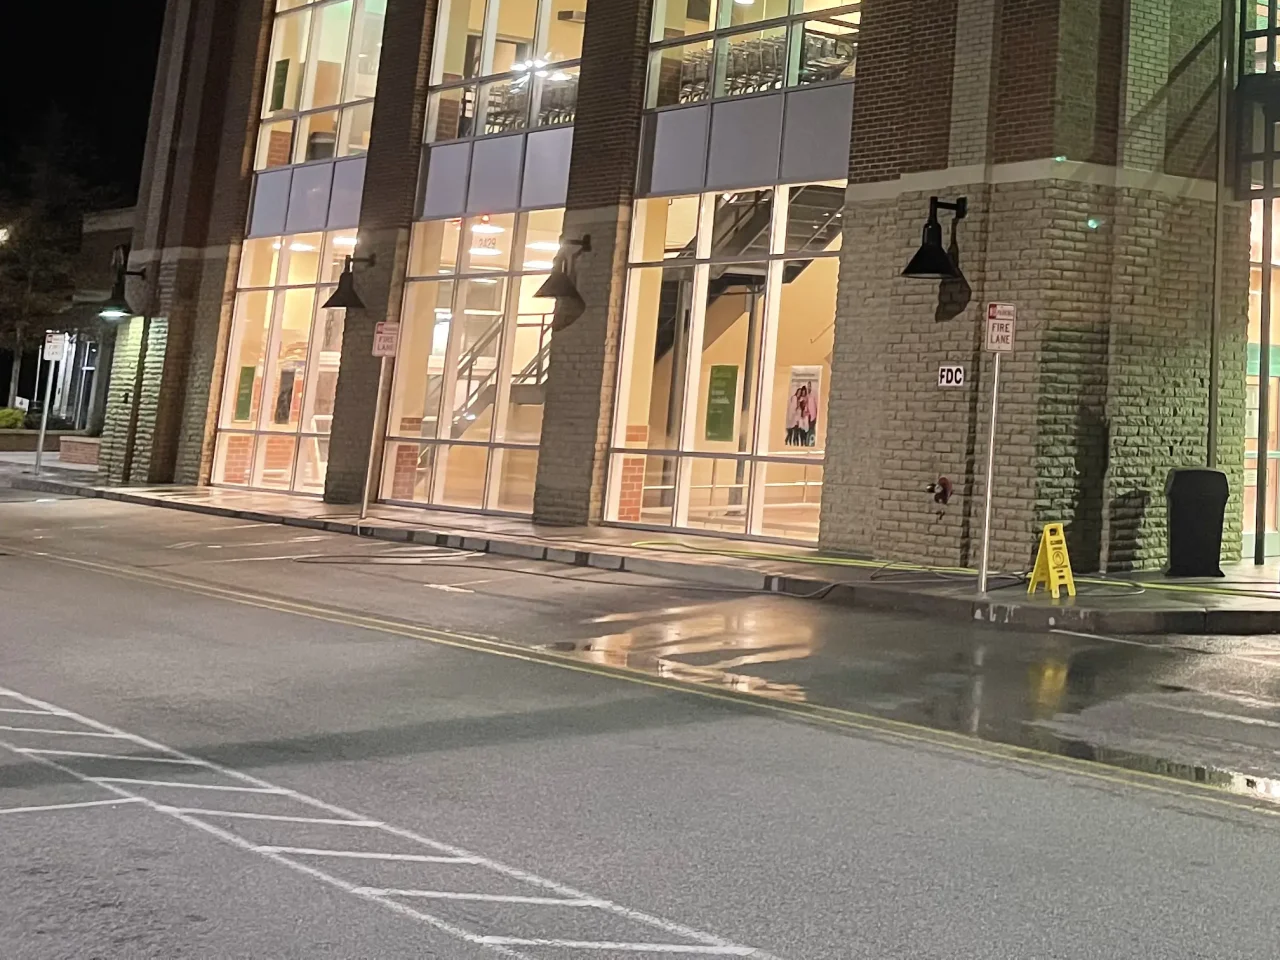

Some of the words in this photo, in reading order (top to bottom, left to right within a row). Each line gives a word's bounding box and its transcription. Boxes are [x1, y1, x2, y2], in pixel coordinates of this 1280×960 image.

[992, 323, 1010, 333] FIRE
[991, 335, 1010, 344] LANE
[939, 368, 962, 384] FDC
